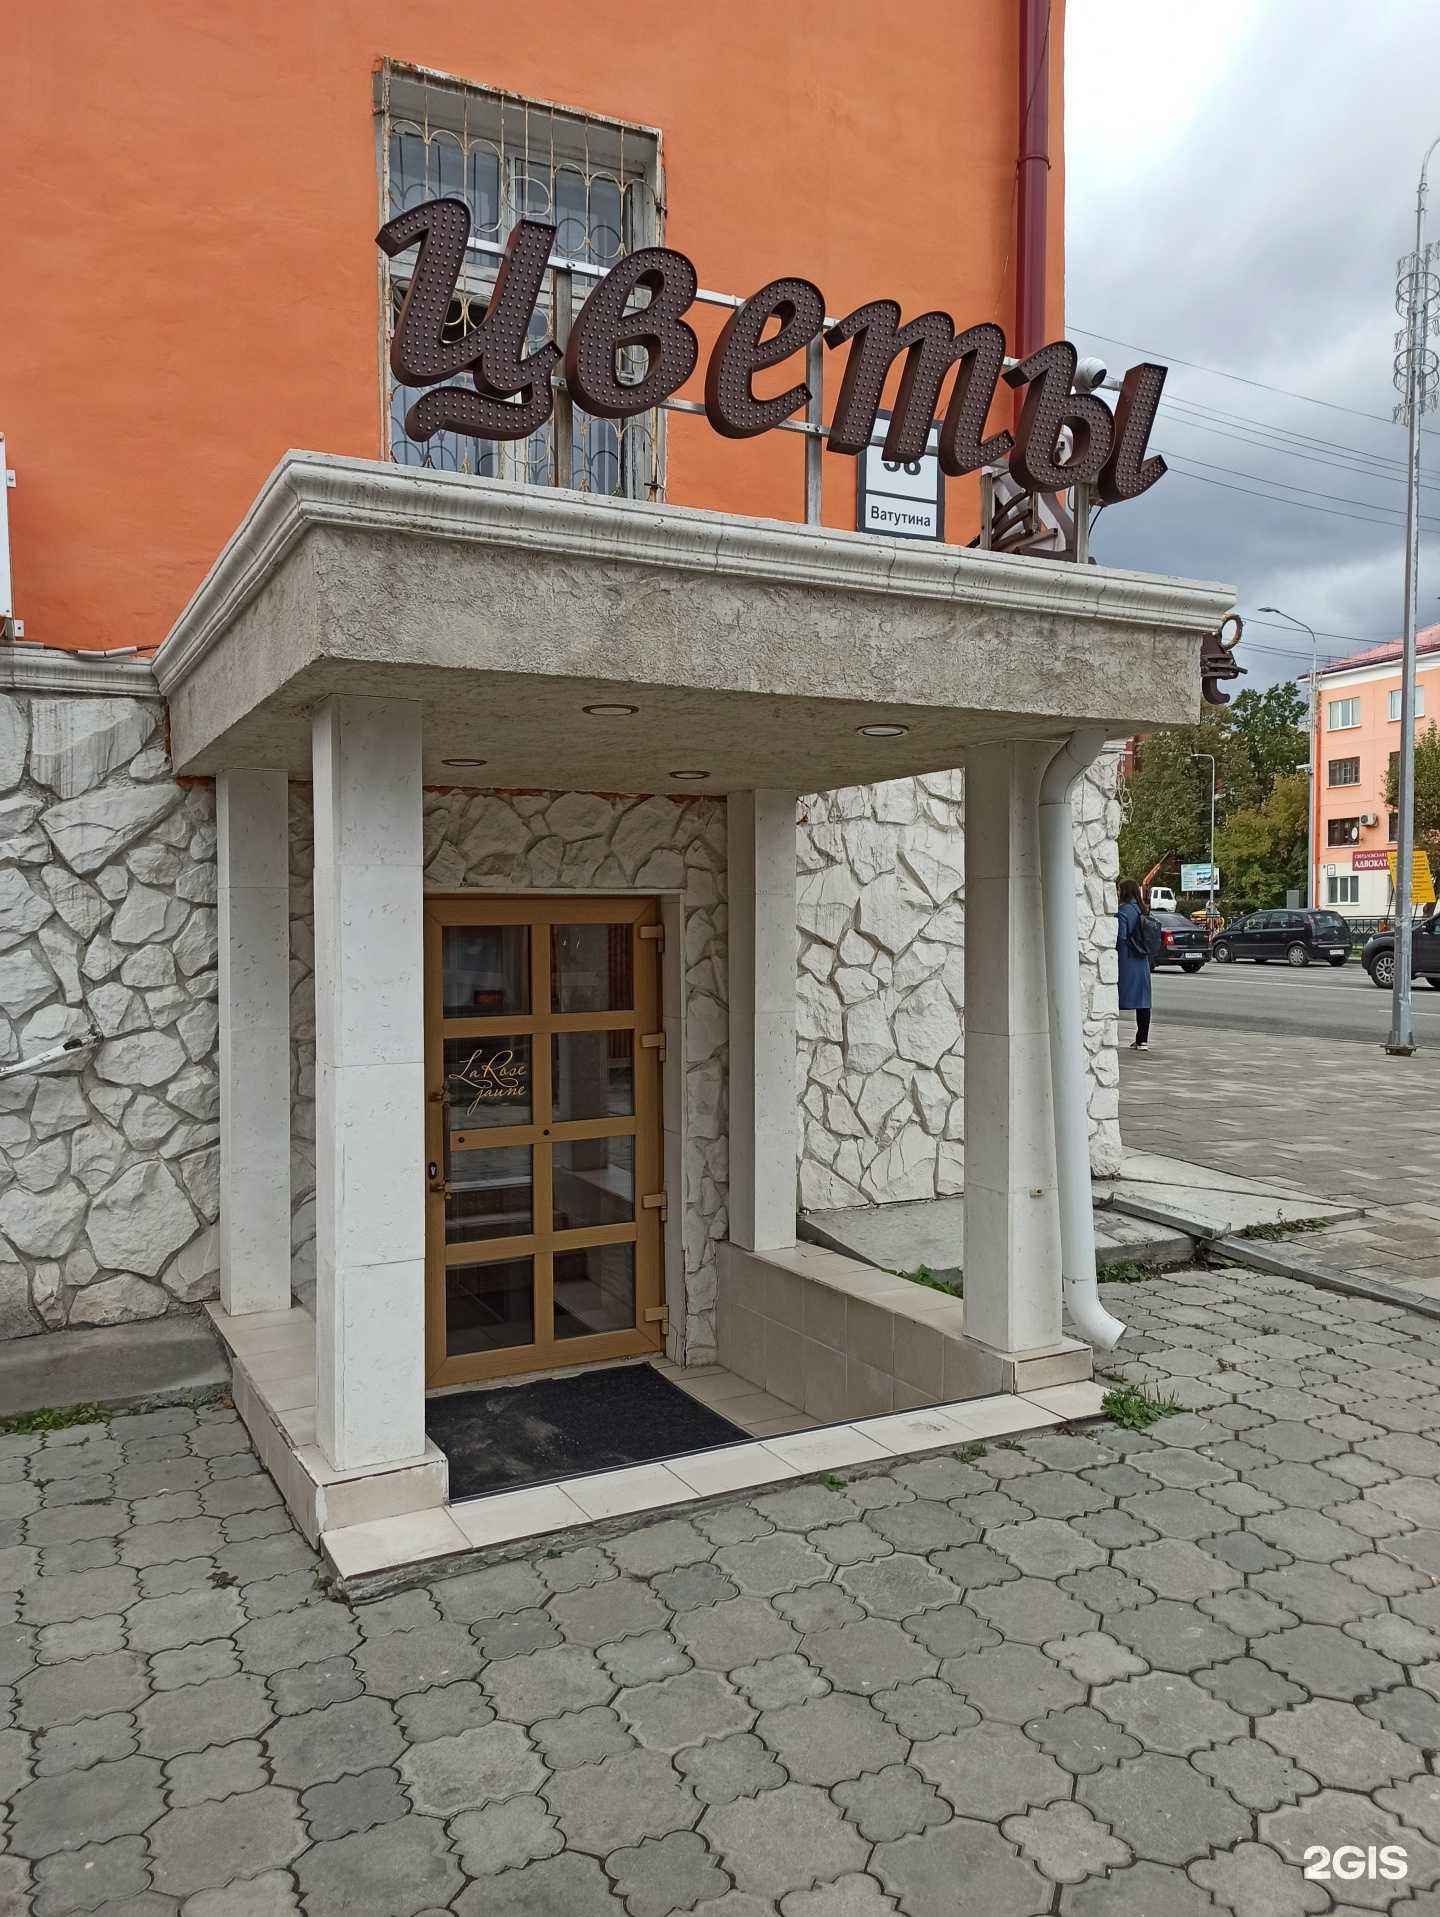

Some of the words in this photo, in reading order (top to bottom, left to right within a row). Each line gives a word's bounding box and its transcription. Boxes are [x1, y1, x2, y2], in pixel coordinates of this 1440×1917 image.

[871, 506, 931, 527] Ватутина
[449, 1049, 492, 1089] La
[482, 1050, 527, 1088] Rose
